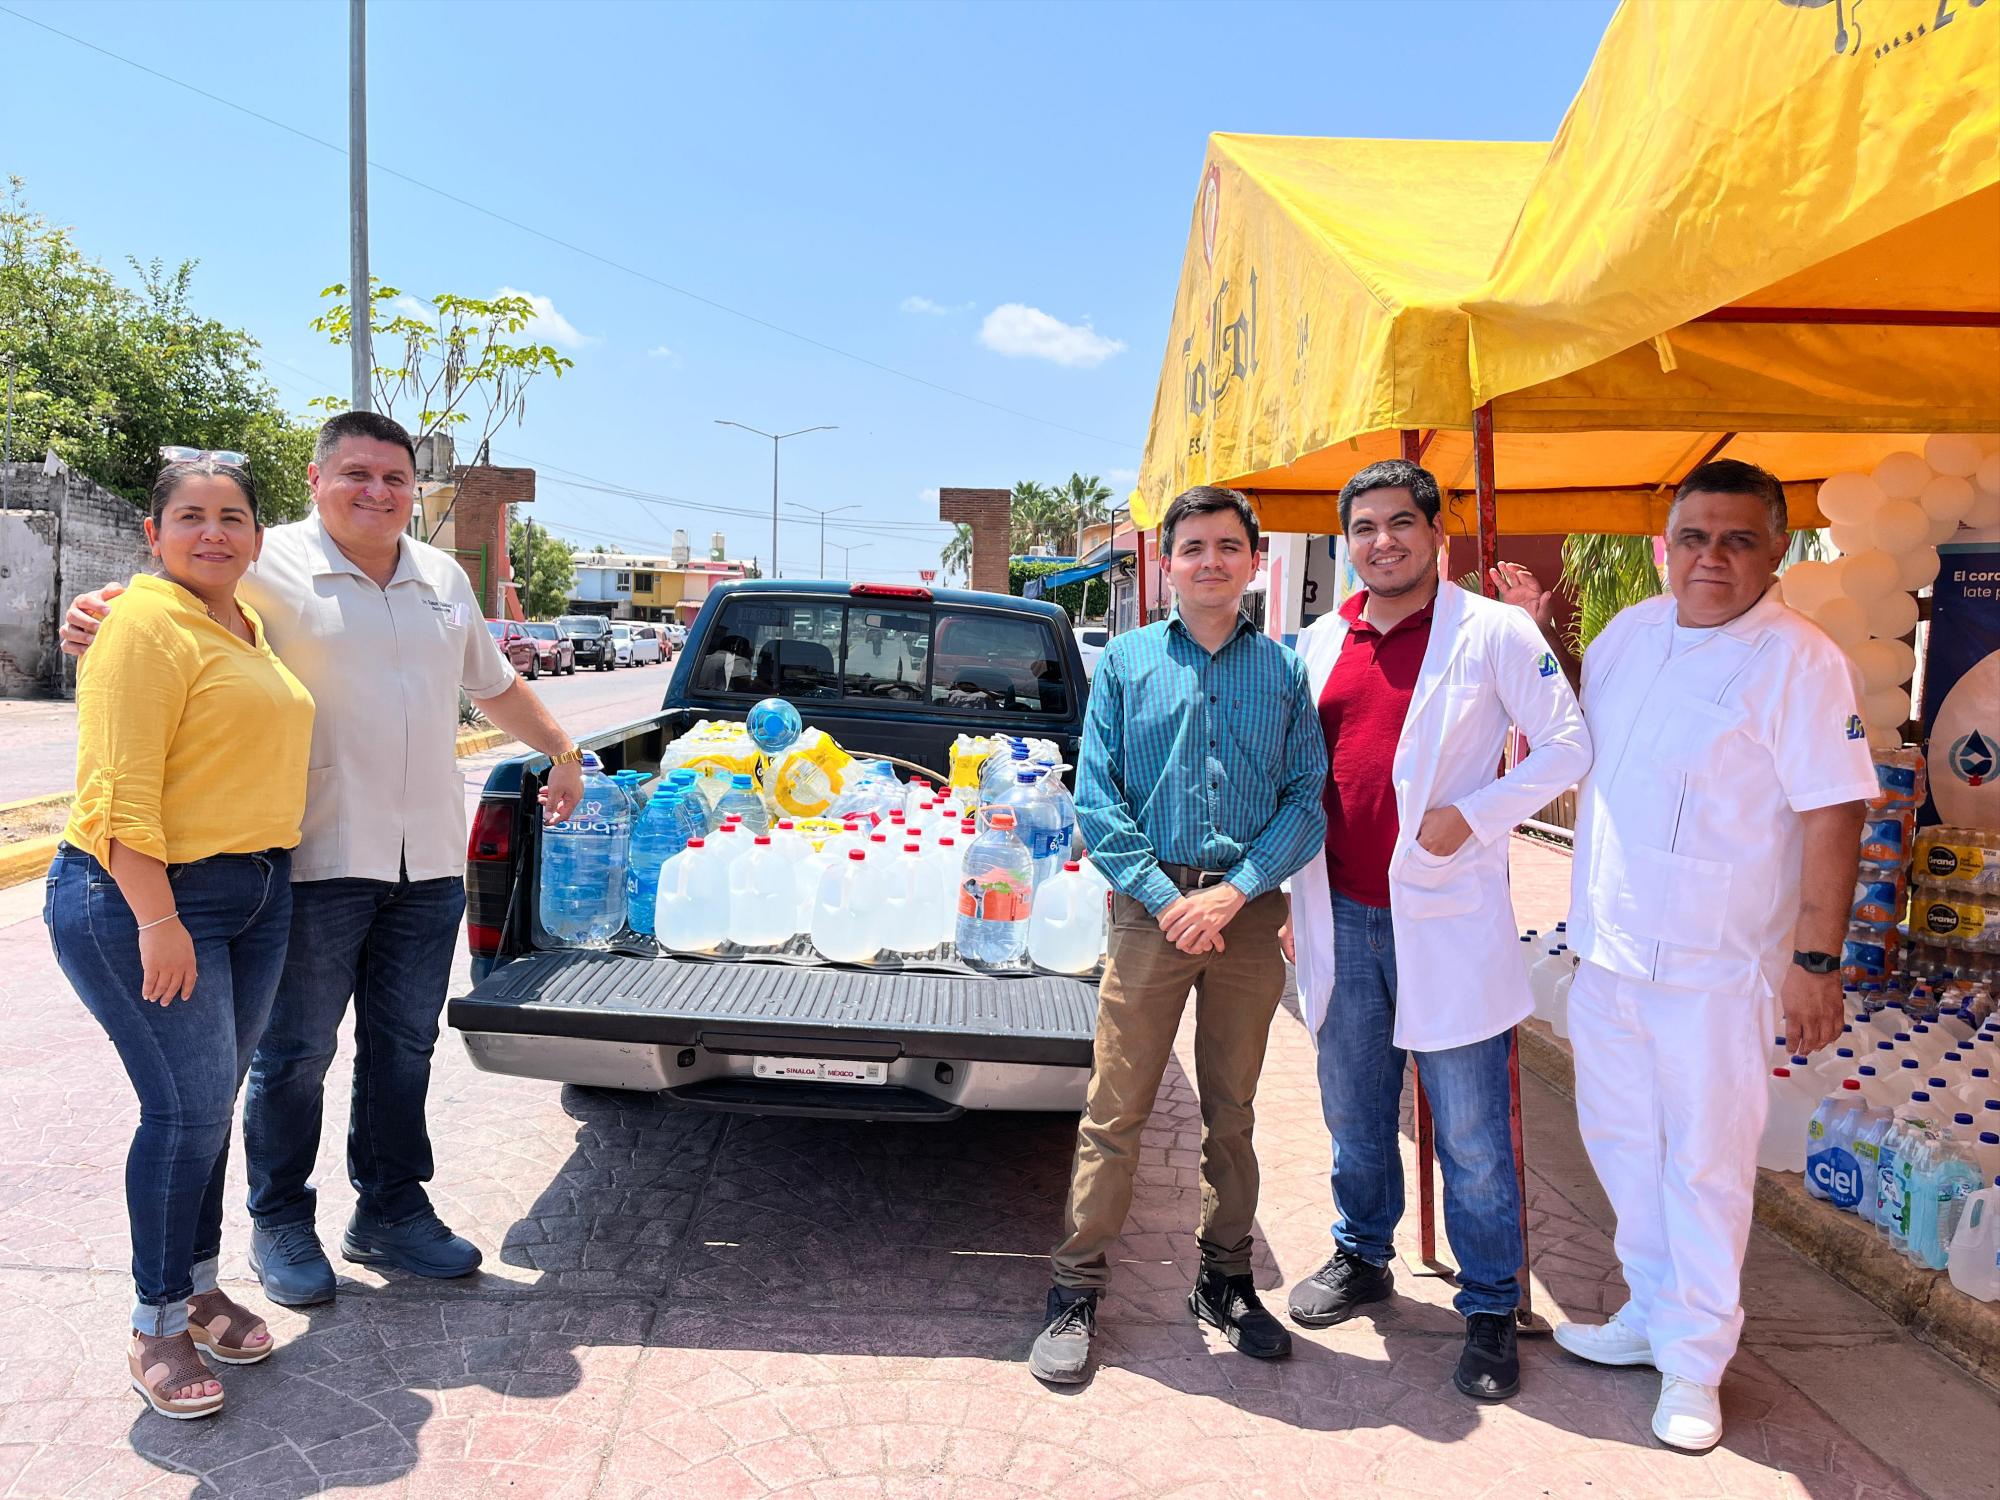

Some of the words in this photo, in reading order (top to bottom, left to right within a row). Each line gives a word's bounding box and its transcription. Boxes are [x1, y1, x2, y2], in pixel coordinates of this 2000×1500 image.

[1954, 571, 1966, 582] El
[1963, 585, 1992, 598] late
[1929, 855, 1956, 866] Grand
[1928, 914, 1957, 925] Grand
[786, 1067, 816, 1075] SINALOA
[1815, 1158, 1857, 1197] ciel
